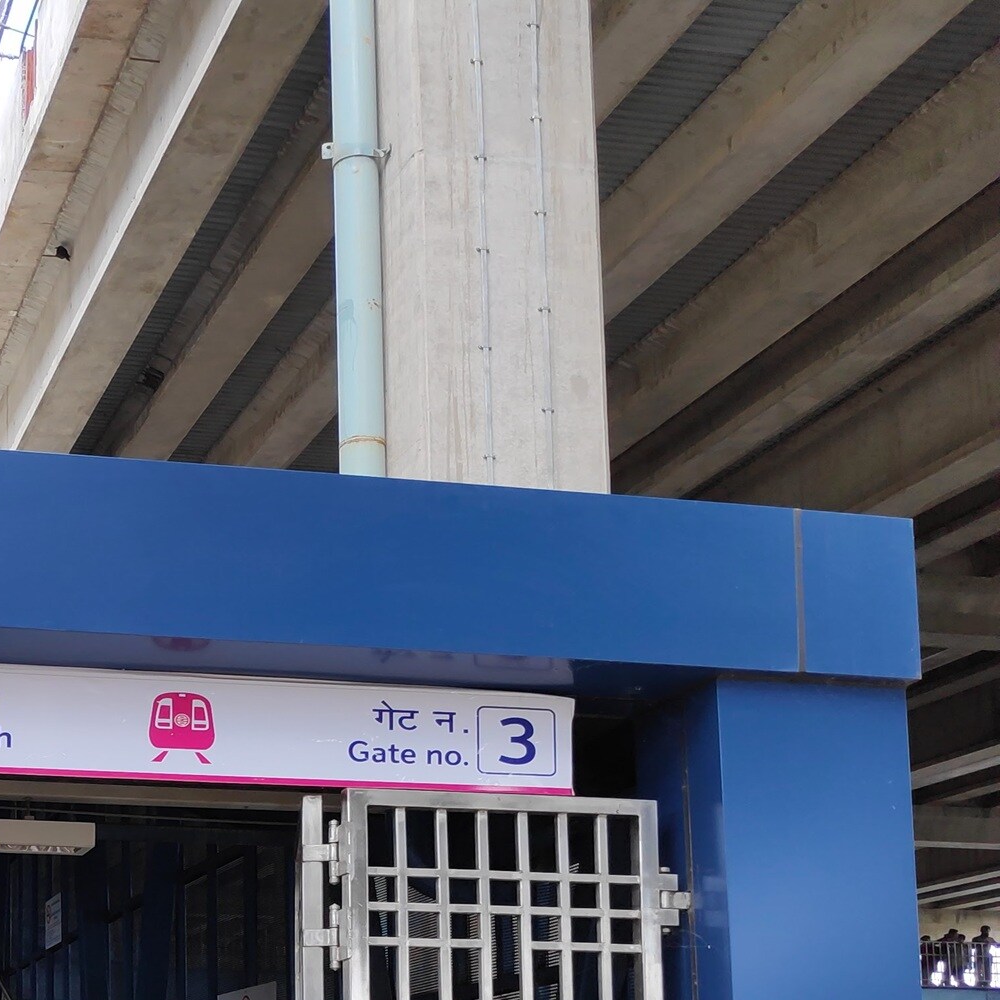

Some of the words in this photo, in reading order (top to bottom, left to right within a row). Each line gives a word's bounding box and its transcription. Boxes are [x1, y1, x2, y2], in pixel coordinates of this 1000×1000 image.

[372, 700, 418, 731] गेट
[348, 740, 417, 765] Gate
[427, 748, 469, 767] no.
[498, 716, 537, 766] 3
